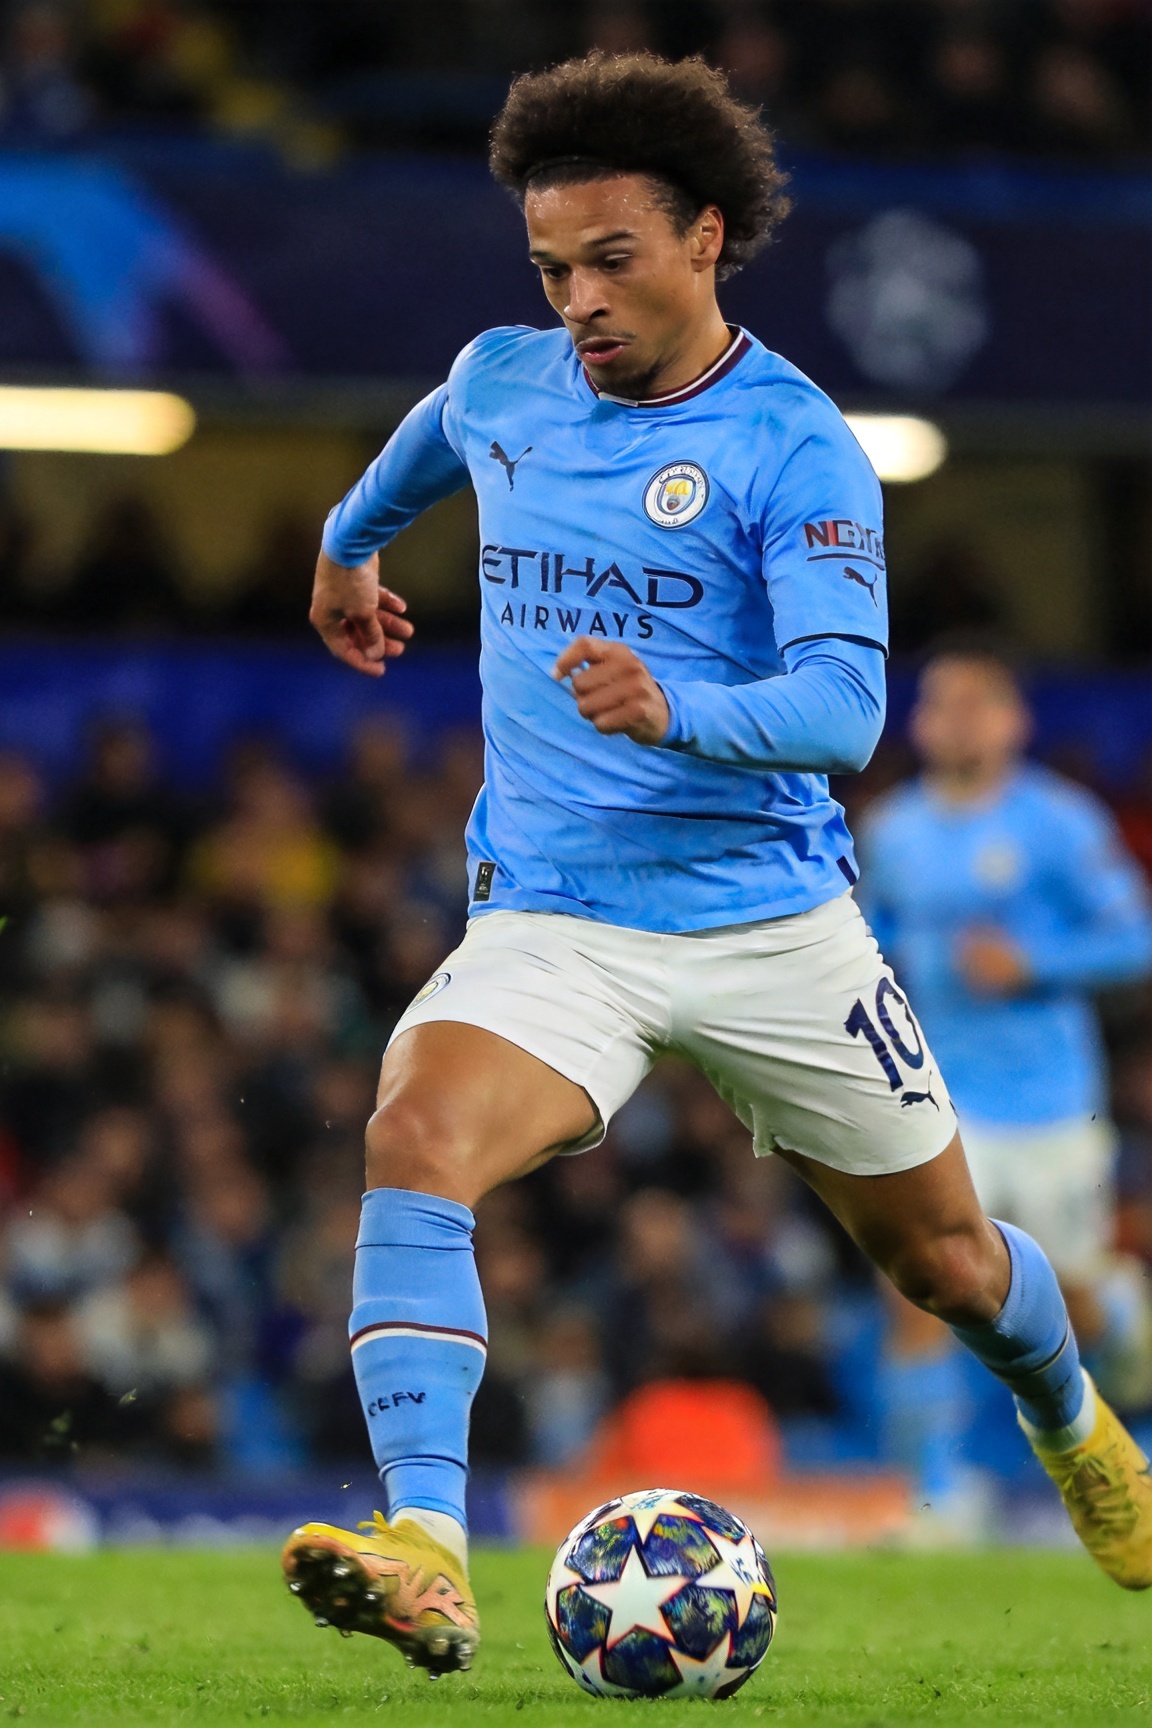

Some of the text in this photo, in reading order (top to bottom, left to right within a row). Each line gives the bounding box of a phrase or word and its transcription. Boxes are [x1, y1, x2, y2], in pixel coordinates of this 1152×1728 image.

[482, 544, 704, 609] ETIHAD
[500, 602, 654, 640] AIRWAYS
[843, 976, 924, 1092] 10
